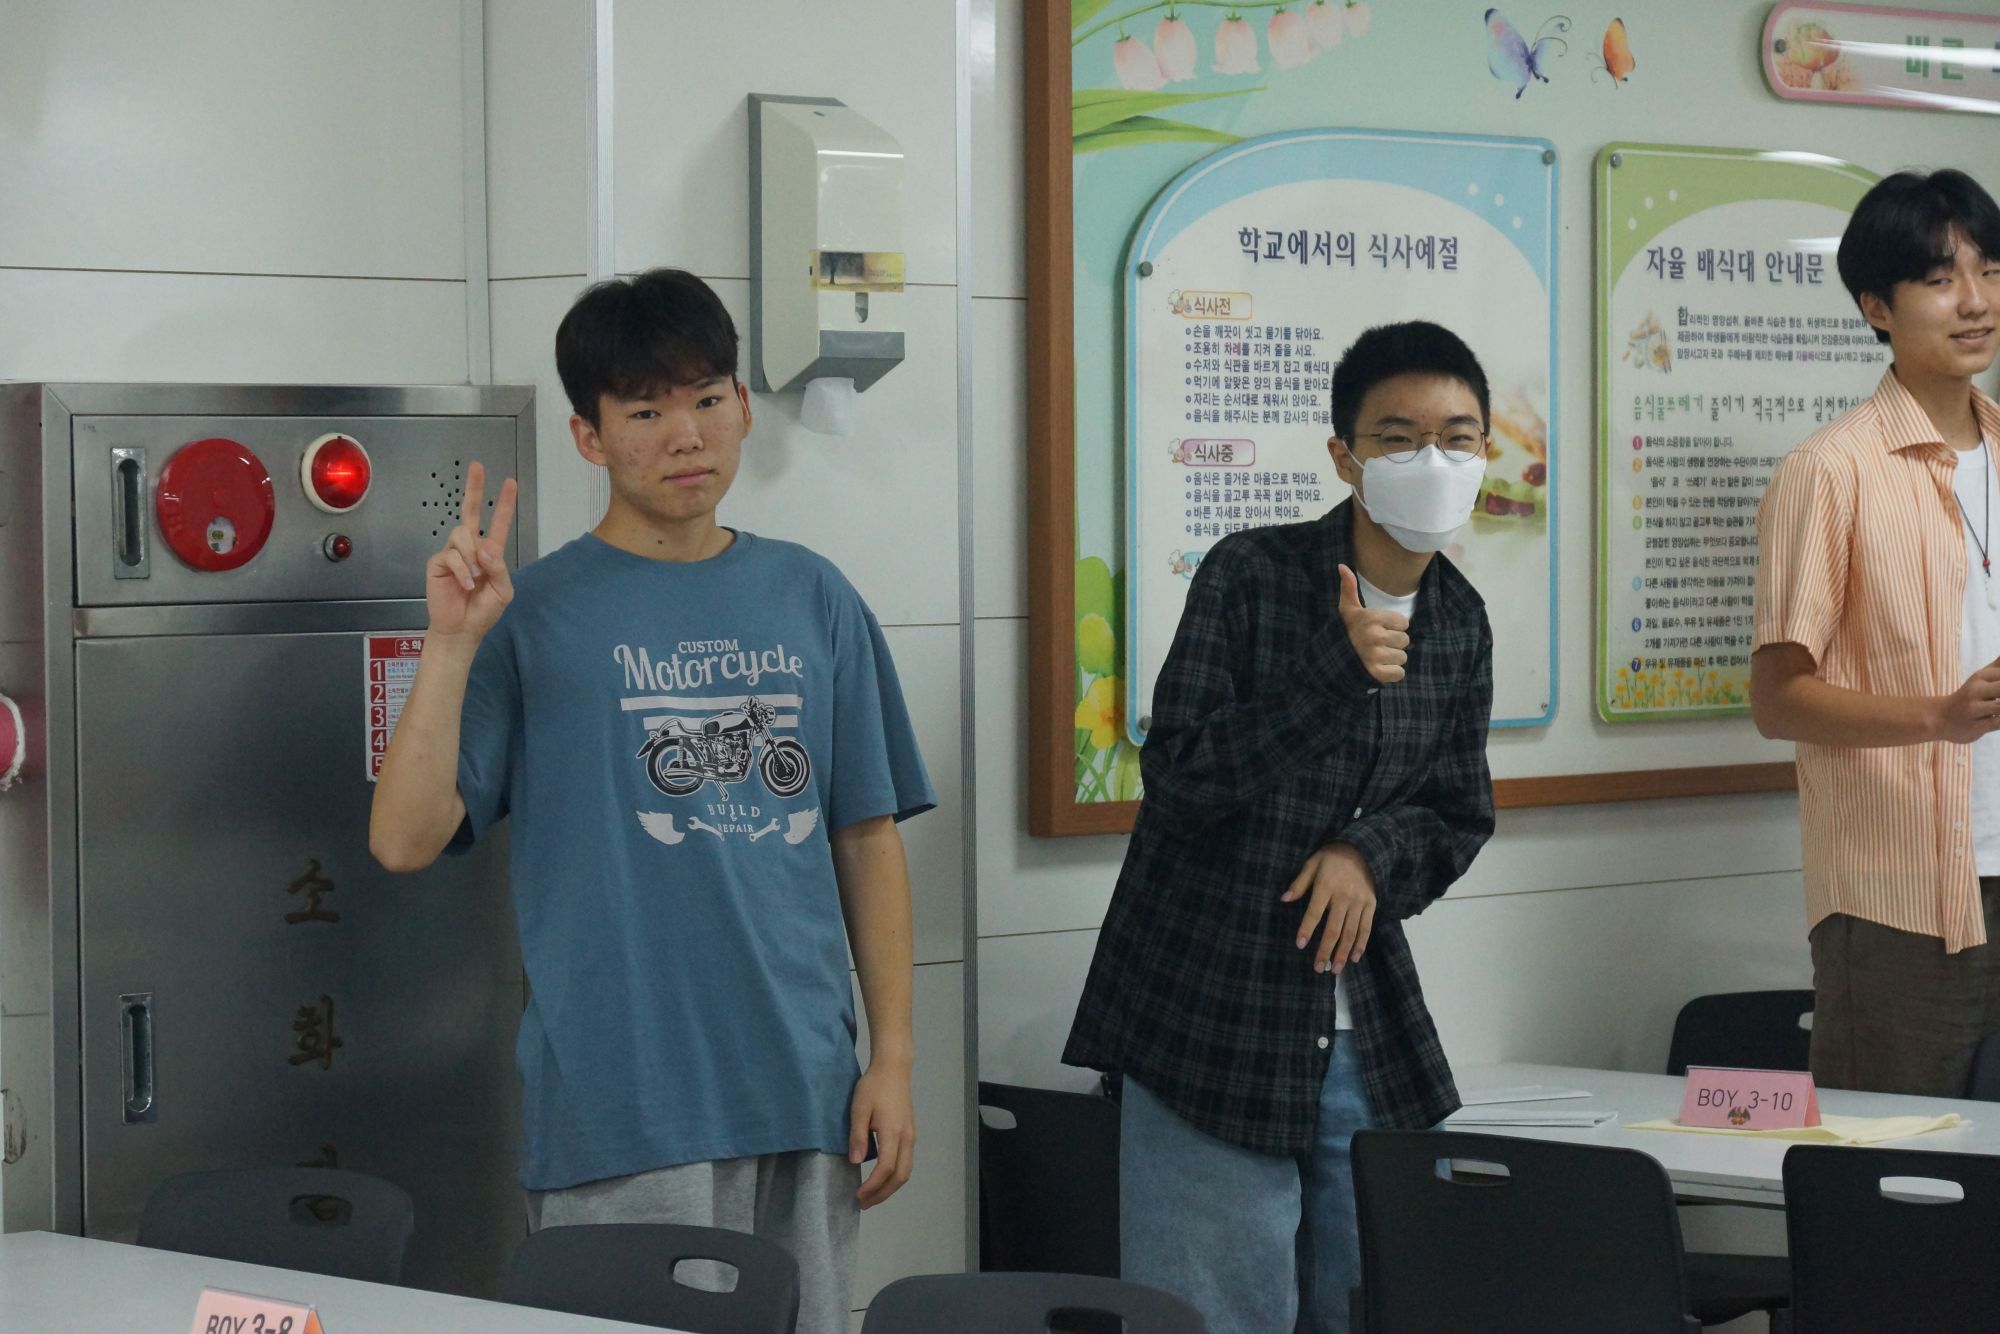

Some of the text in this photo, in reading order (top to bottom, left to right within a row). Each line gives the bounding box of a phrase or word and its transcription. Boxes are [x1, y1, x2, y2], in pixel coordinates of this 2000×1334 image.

[1238, 227, 1458, 270] 학교에서의 식사예절
[1647, 246, 1824, 284] 자율 배식대 안내문
[1194, 297, 1231, 316] 식사전
[1194, 325, 1324, 341] 손을 깨끗이 씻고 물기를 닦아요.
[1194, 342, 1315, 357] 조용히 차례를 지켜 줄을 서요.
[1194, 359, 1220, 372] 수저와
[1224, 359, 1250, 372] 식판을
[1254, 360, 1280, 373] 바르게
[1284, 361, 1300, 374] 잡고
[1304, 361, 1329, 374] 배식대
[1194, 376, 1220, 389] 먹기에
[1254, 378, 1270, 390] 양의
[1275, 378, 1300, 390] 음식을
[1194, 393, 1320, 407] 자리는 순서대로 채워서 앉아요.
[1633, 394, 1866, 422] 음식물쓰레기 줄이기 적극적으로 실천하시
[1194, 409, 1331, 424] 음식을 해주시는 분께 감사의 마음
[1194, 444, 1234, 462] 식사중
[1194, 472, 1321, 486] 음식은 즐거운 마음으로 먹어요.
[1194, 489, 1324, 502] 음식을 골고루 꼭꼭 씹어 먹어요.
[1215, 506, 1241, 519] 자세로
[1245, 506, 1271, 519] 앉아서
[1275, 506, 1303, 519] 먹어요.
[1194, 523, 1220, 537] 음식을
[678, 639, 739, 654] CUSTOM
[373, 661, 381, 680] 1
[613, 644, 803, 691] Motorcycle
[374, 685, 384, 703] 2
[374, 707, 384, 727] 3
[373, 732, 384, 750] 4
[707, 804, 760, 818] BUILD
[718, 824, 754, 832] REPAIR
[1697, 1088, 1793, 1111] BOY 3-10
[205, 1313, 293, 1334] BOY 3-8
